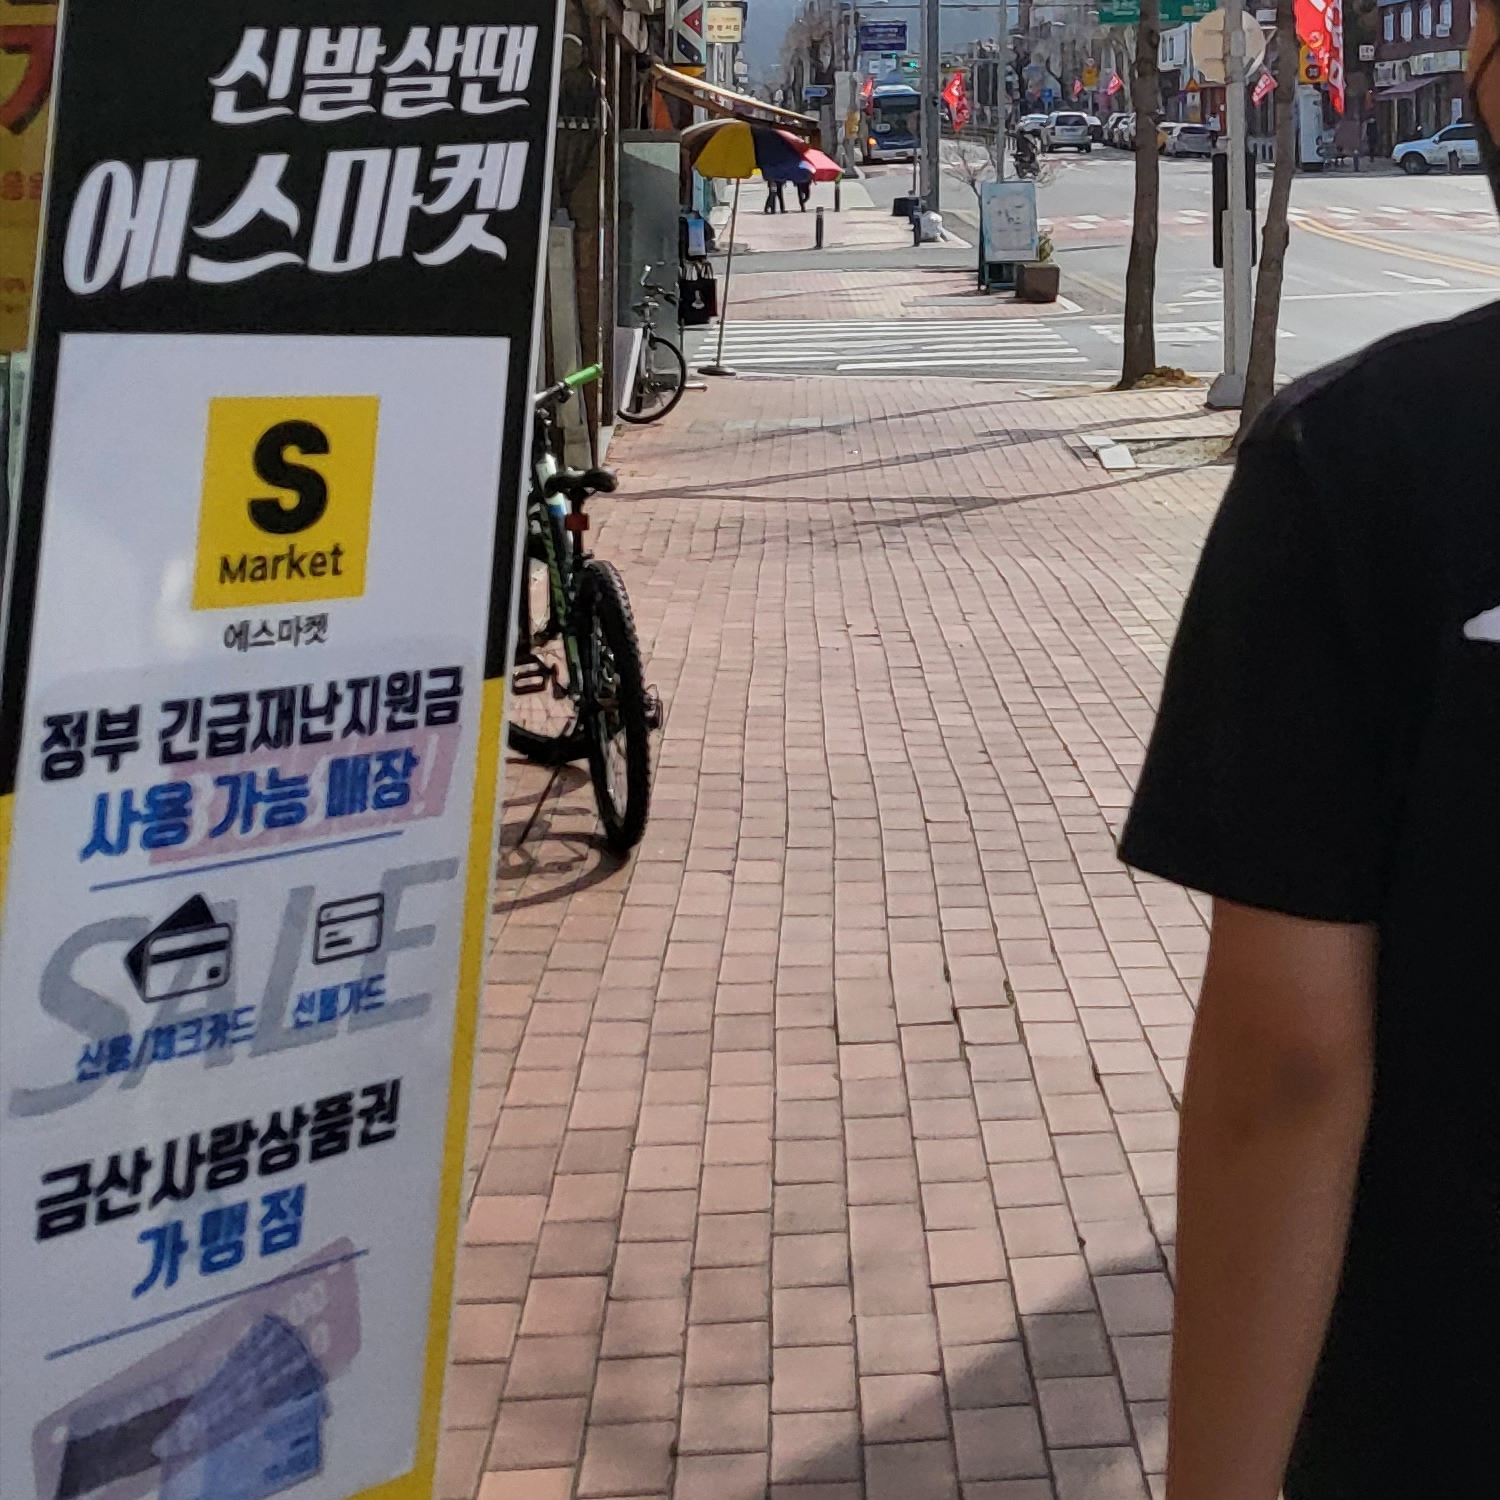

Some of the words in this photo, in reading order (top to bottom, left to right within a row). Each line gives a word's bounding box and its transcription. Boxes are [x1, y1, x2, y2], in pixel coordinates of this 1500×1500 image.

[209, 25, 539, 125] 신발살땐
[62, 141, 530, 296] 에스마켓
[247, 419, 331, 535] S
[218, 543, 346, 585] Market
[223, 612, 330, 652] 에스마켓
[40, 704, 142, 783] 정부
[158, 665, 464, 766] 긴급재난지원금
[80, 781, 193, 864] 사용
[209, 766, 310, 840] 가능
[325, 746, 420, 820] 매장
[33, 1076, 403, 1243] 금산사랑상품권
[131, 1182, 308, 1300] 가맹점
